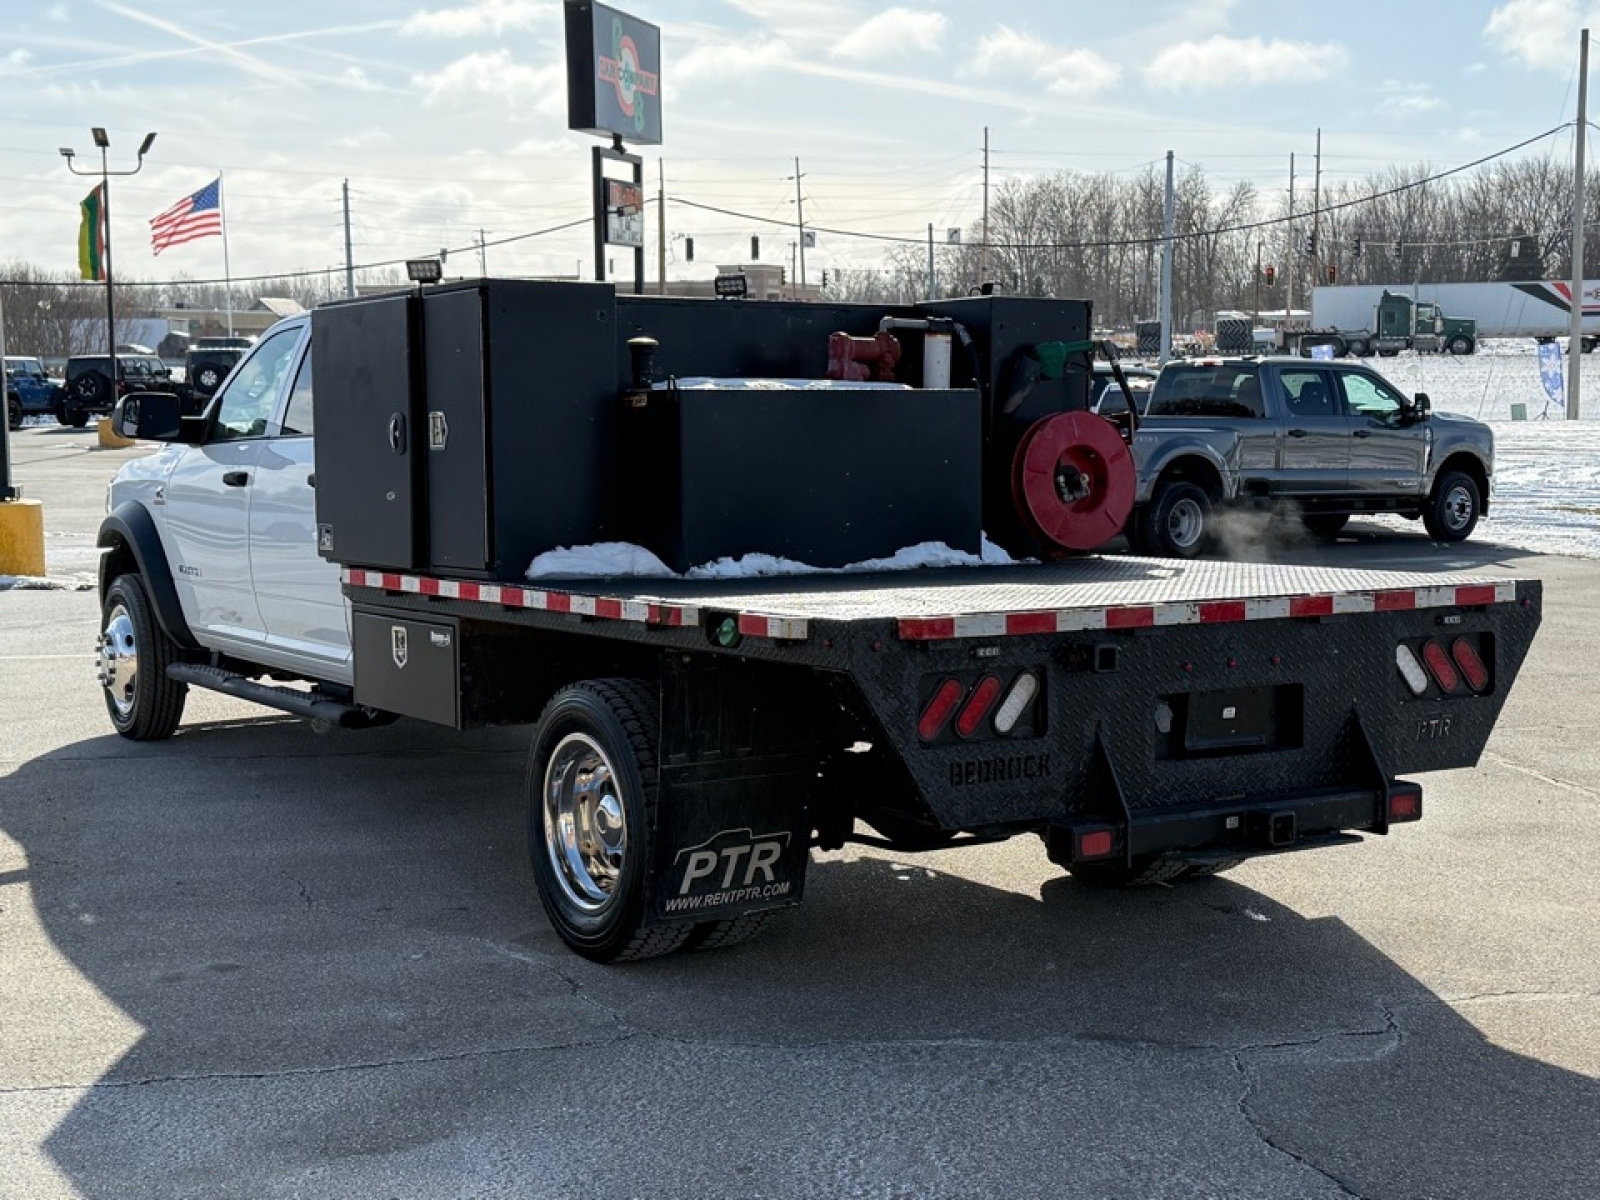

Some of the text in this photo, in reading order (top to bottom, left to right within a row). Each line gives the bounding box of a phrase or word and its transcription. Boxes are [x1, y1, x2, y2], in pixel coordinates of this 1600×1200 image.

[950, 754, 1051, 787] BEDROCK
[679, 841, 781, 894] PTR
[665, 881, 791, 911] WWW.RENTPTR.COM
